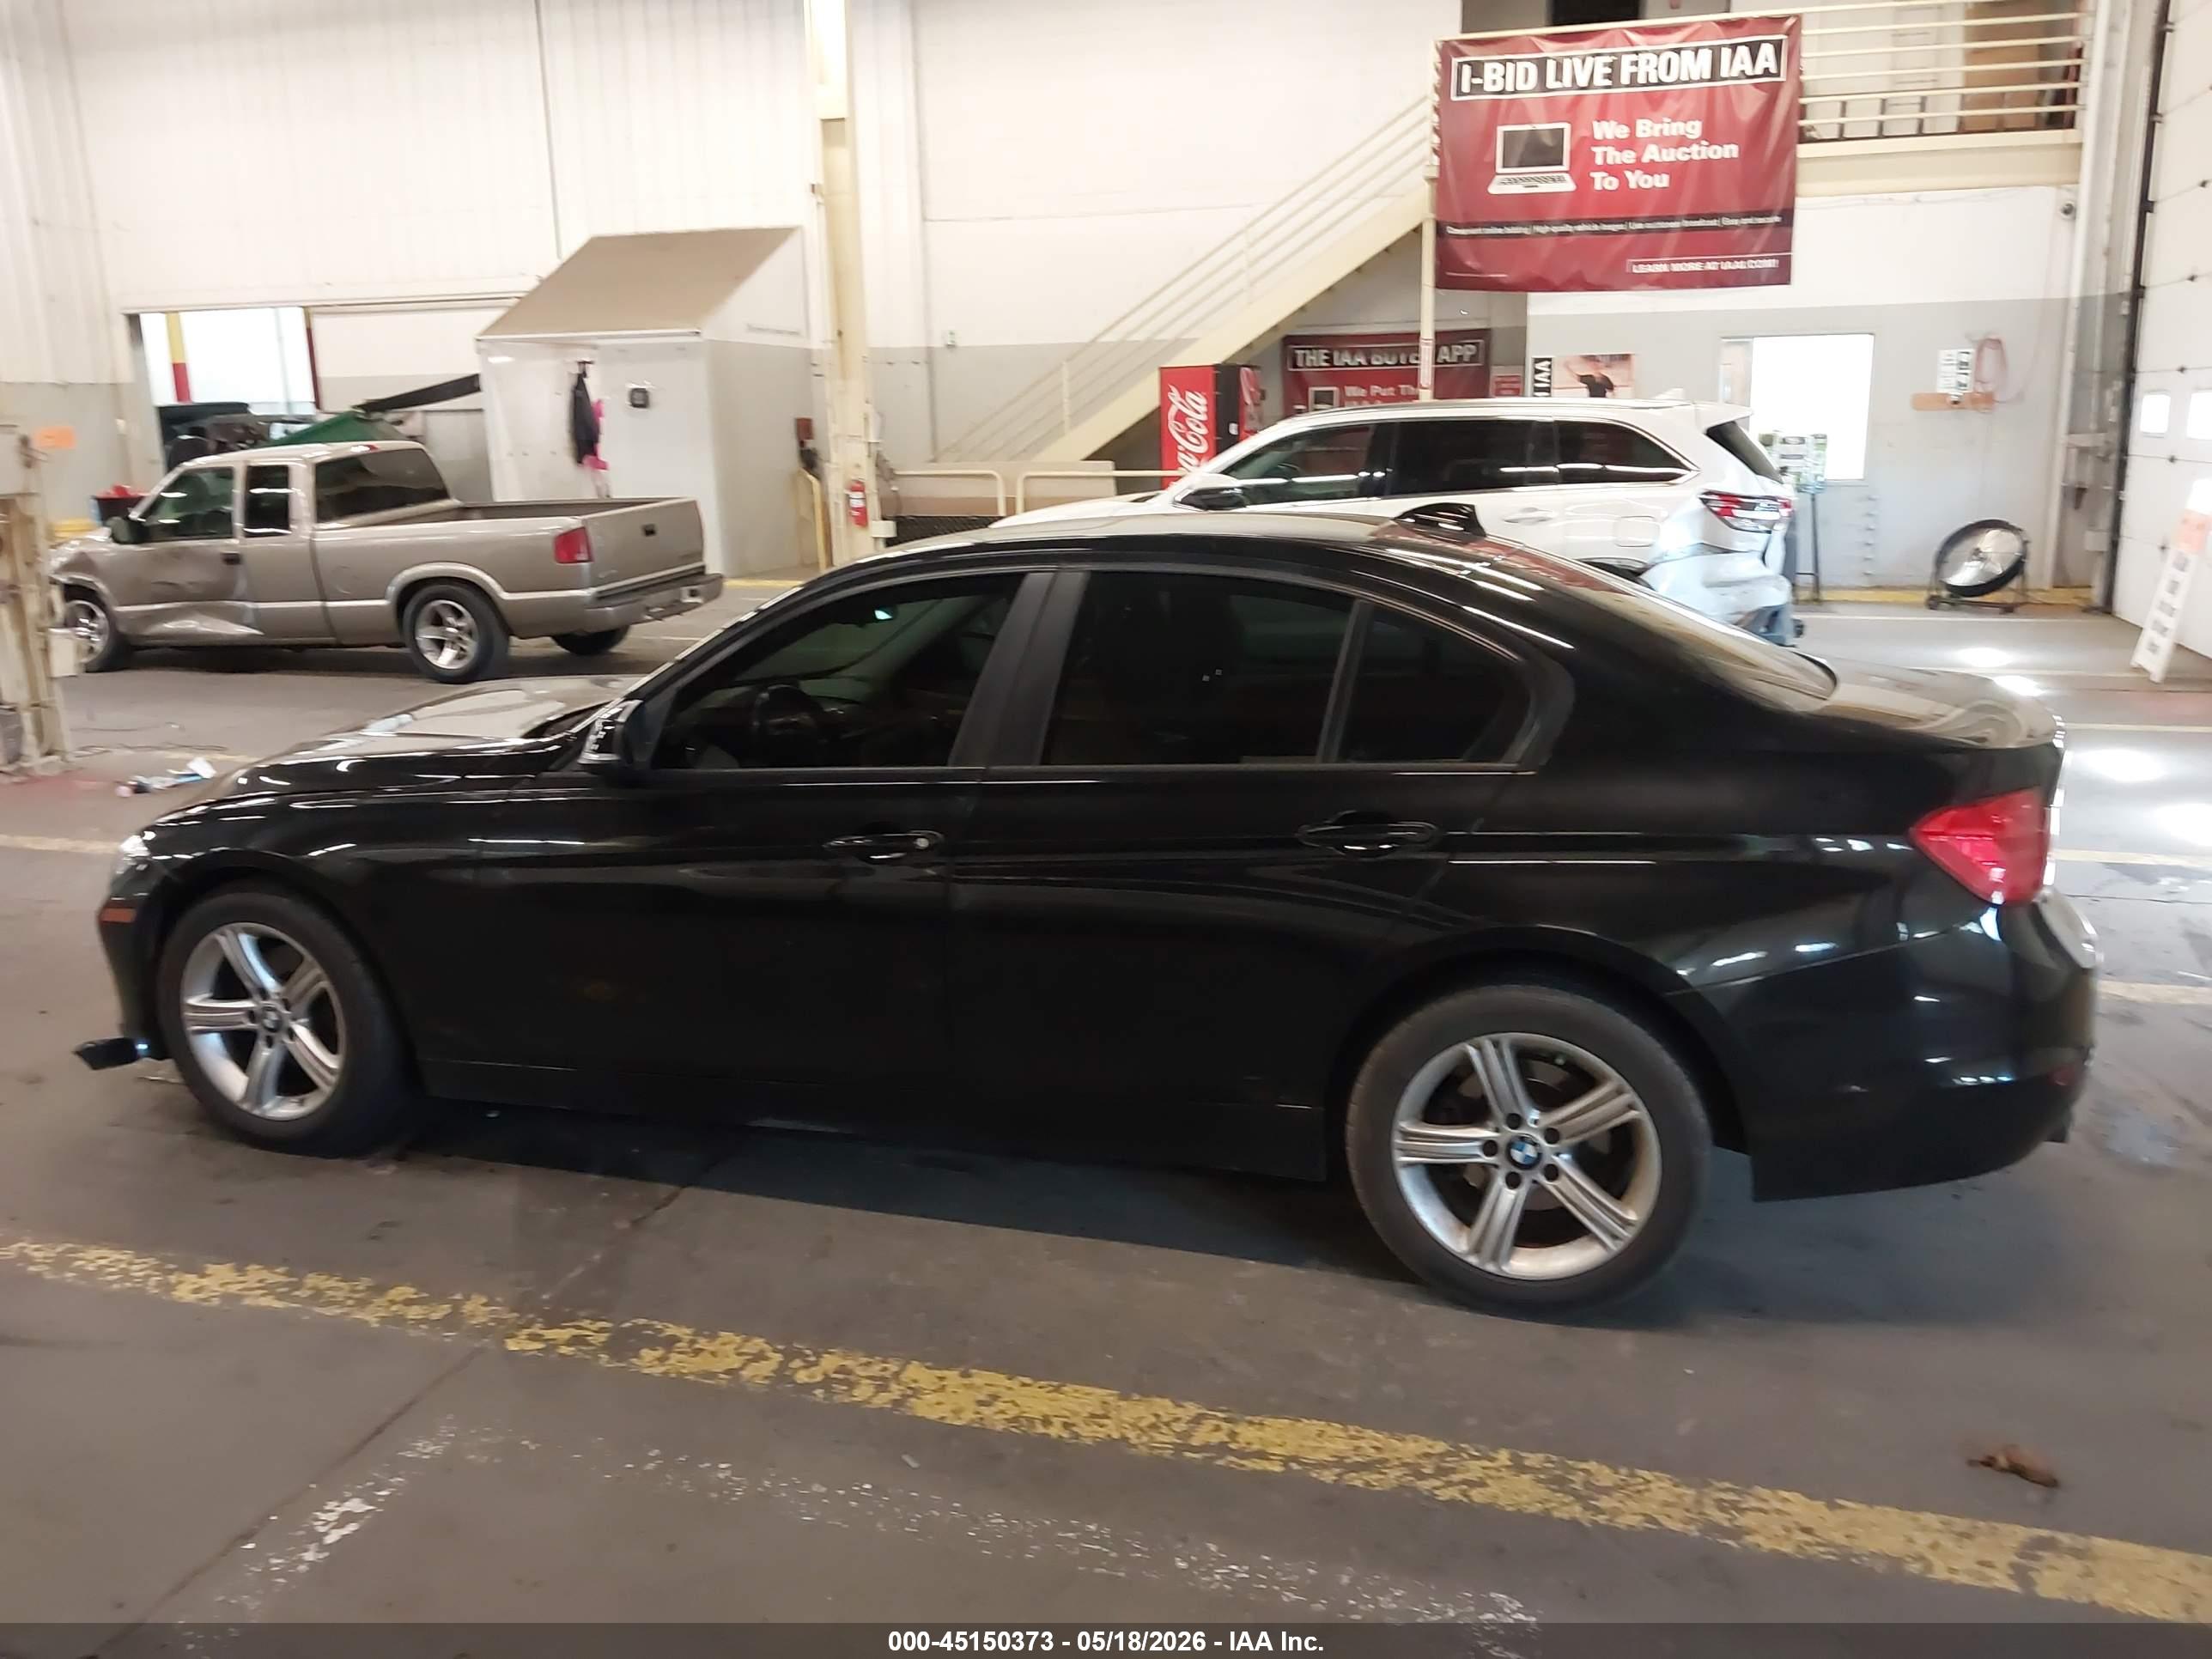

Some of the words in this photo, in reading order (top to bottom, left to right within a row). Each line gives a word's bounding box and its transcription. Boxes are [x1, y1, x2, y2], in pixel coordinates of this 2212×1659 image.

[1461, 61, 1539, 94] I-BID
[1545, 56, 1613, 89] LIVE
[1619, 47, 1713, 84] FROM
[1719, 42, 1778, 77] IAA
[1591, 120, 1631, 140] We
[1635, 118, 1703, 140] Bring
[1591, 146, 1637, 166] The
[1640, 140, 1739, 163] Auction
[1590, 171, 1620, 191] To
[1626, 168, 1669, 189] You
[1295, 349, 1330, 368] THE
[1333, 349, 1368, 366] IAA
[1437, 343, 1477, 363] APP
